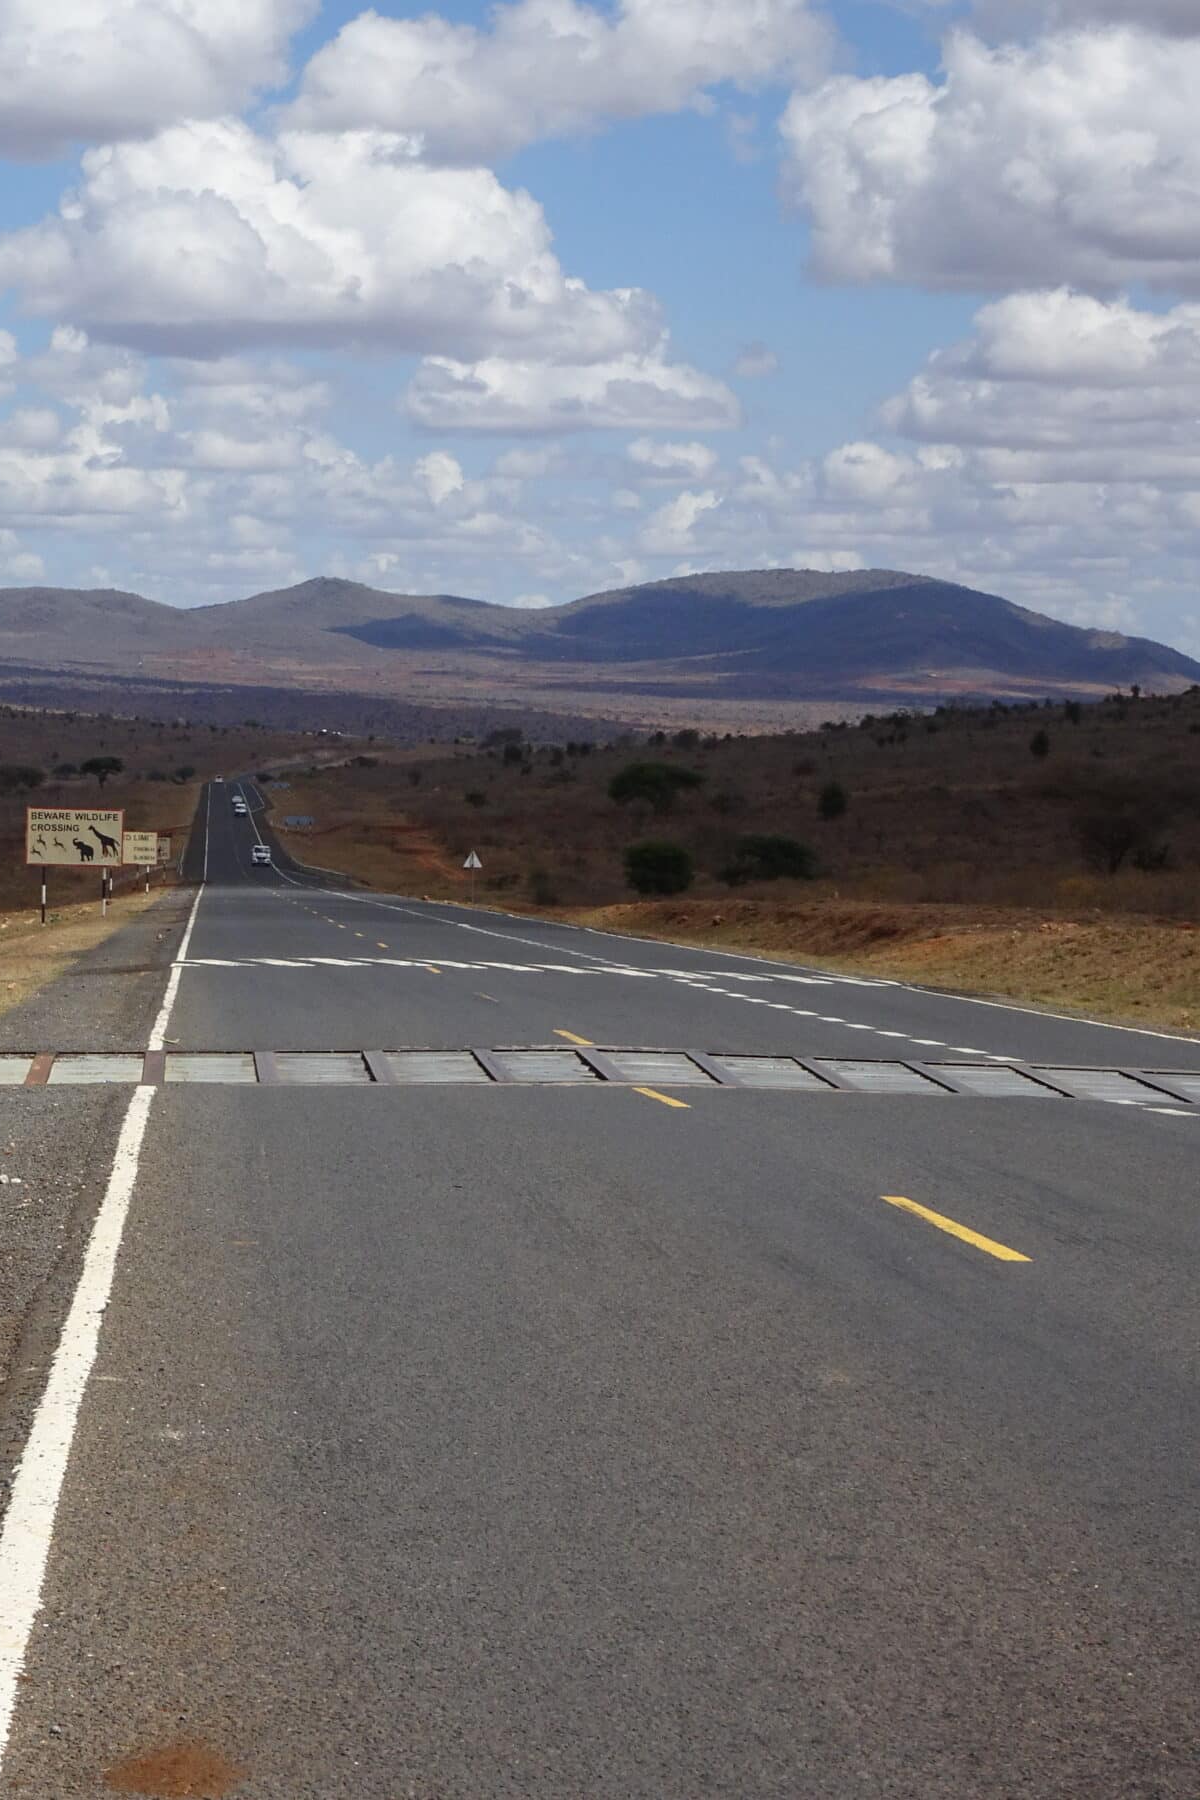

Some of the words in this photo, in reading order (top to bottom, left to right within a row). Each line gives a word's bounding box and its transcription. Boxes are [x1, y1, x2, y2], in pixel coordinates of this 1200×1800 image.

[31, 811, 71, 821] BEWARE
[75, 812, 119, 822] WILDLIFE
[31, 823, 80, 833] CROSSING
